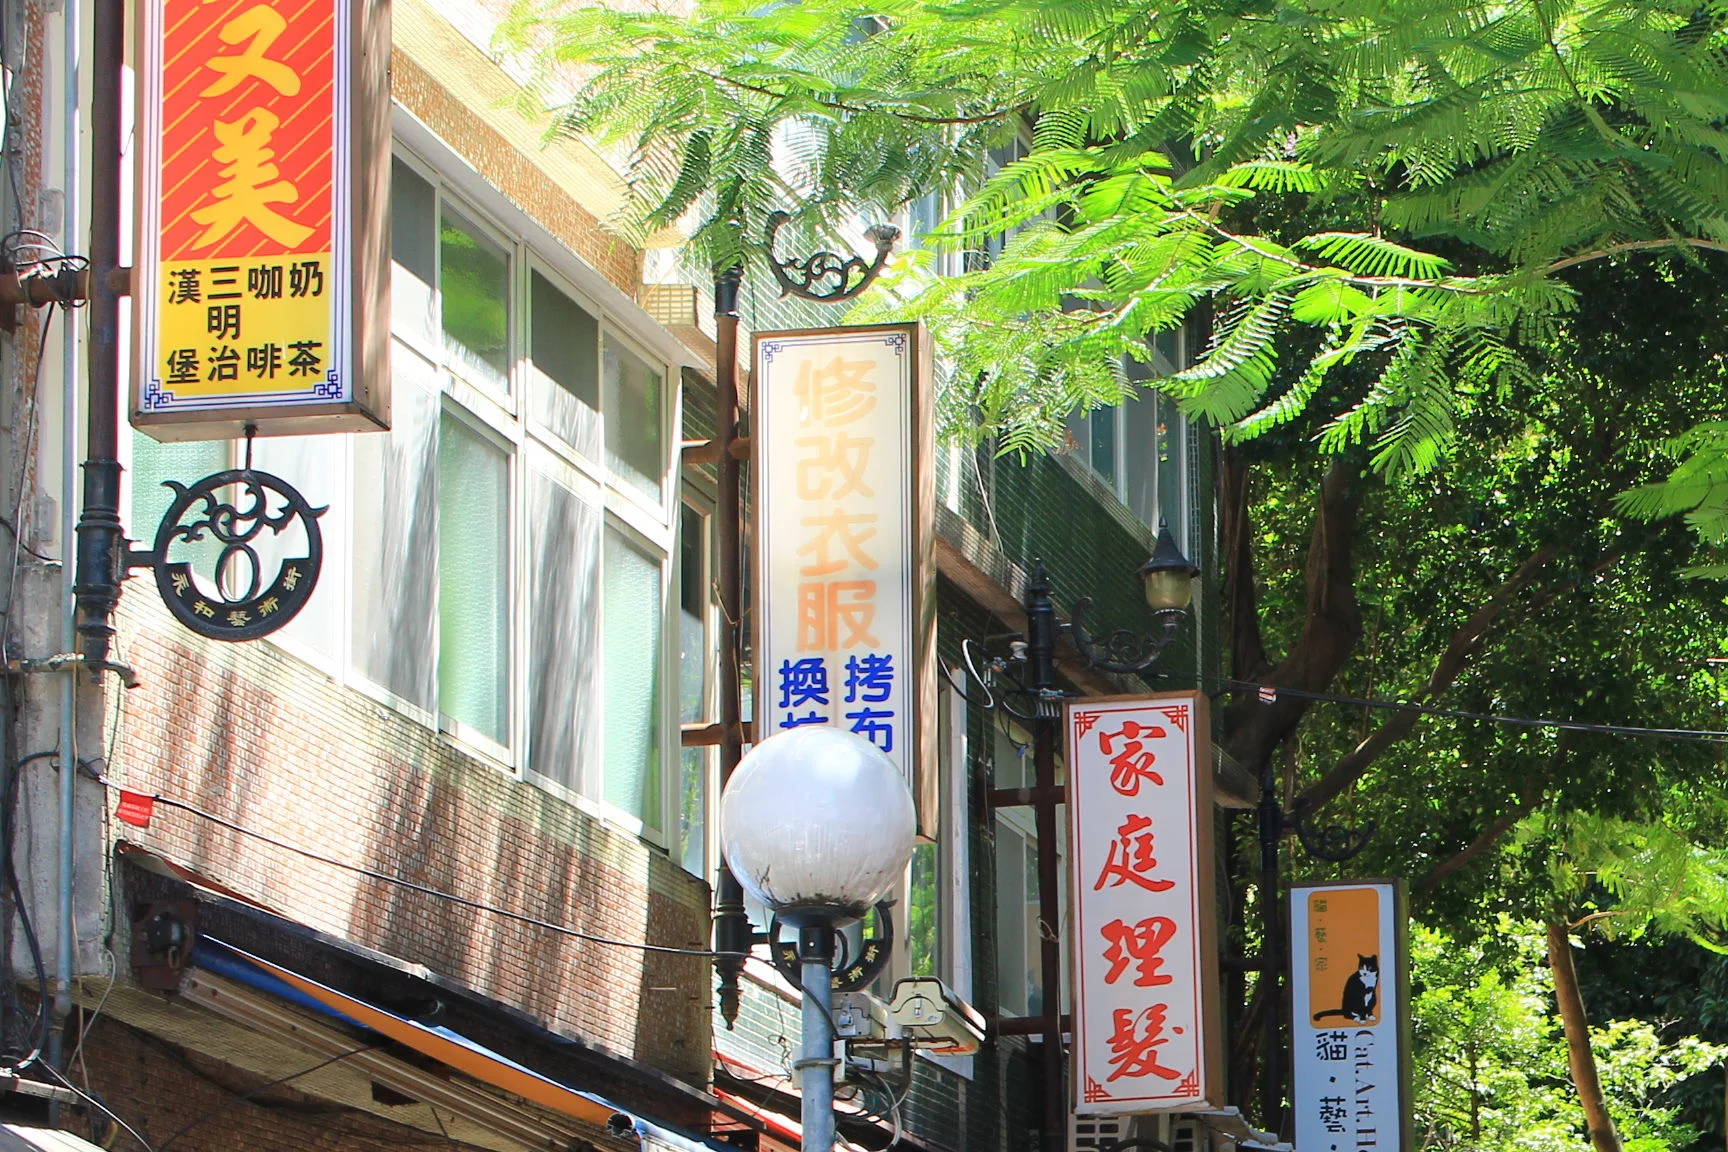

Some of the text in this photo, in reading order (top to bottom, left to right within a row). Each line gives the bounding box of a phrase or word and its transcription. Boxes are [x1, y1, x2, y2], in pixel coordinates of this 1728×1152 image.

[190, 4, 315, 251] 又美
[167, 268, 201, 384] 漢堡
[207, 266, 242, 381] 三明治
[248, 265, 283, 377] 咖啡
[289, 261, 324, 377] 奶茶
[795, 356, 879, 652] 修改衣服
[779, 658, 829, 729] 換
[845, 654, 894, 753] 拷布
[1094, 722, 1183, 1083] 家庭理髮
